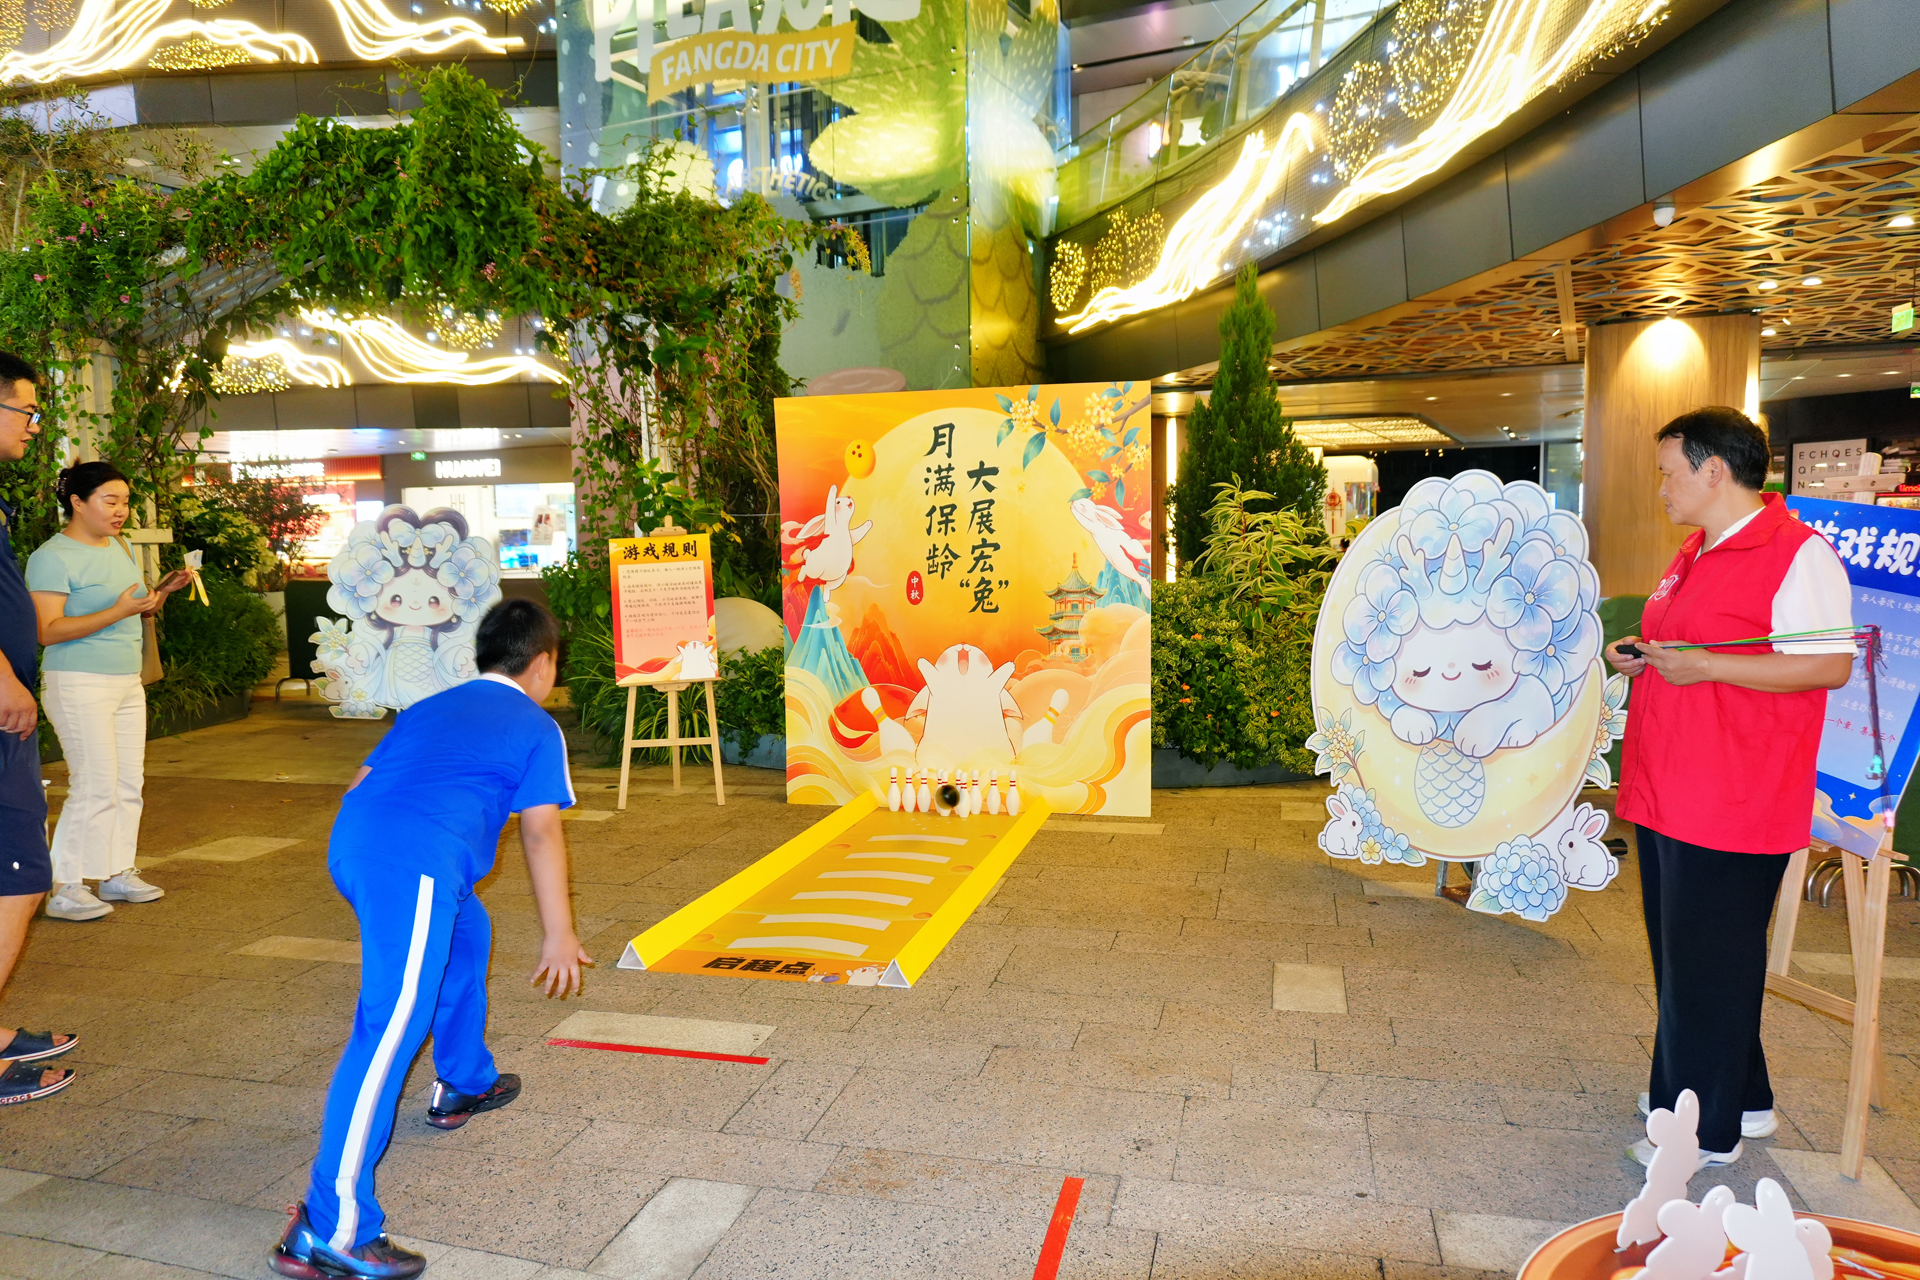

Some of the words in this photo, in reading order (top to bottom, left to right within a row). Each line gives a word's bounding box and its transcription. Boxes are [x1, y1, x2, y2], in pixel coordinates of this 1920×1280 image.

[661, 41, 769, 87] FANGDA
[776, 38, 841, 73] CITY
[924, 422, 961, 580] 月满保龄
[623, 540, 698, 561] 游戏规则
[1805, 519, 1920, 578] 戏规
[910, 575, 921, 600] 中秋
[702, 956, 815, 977] 启程点
